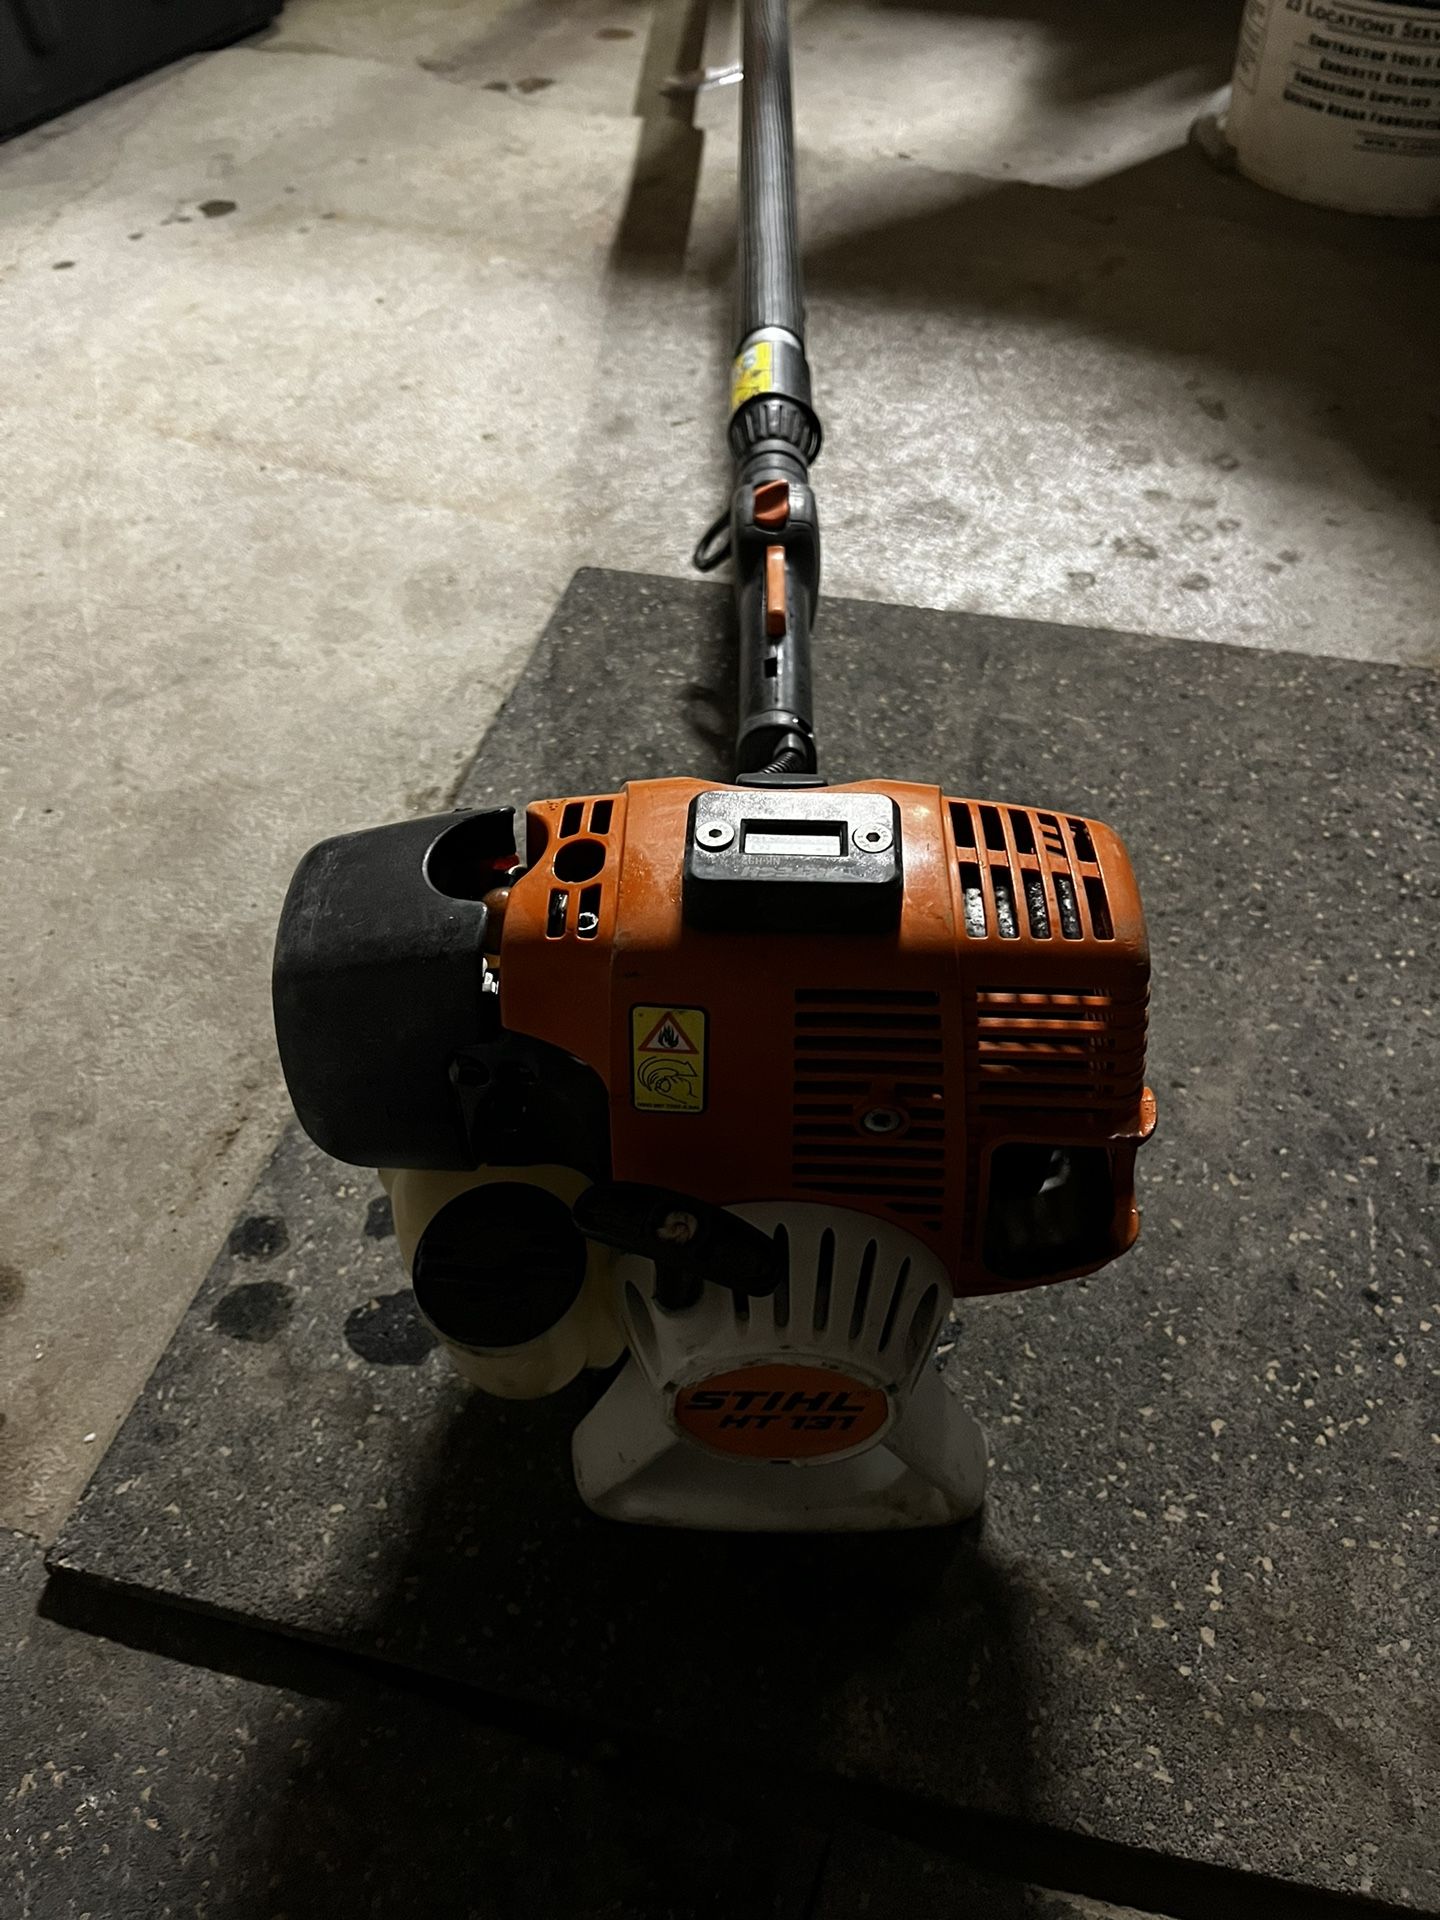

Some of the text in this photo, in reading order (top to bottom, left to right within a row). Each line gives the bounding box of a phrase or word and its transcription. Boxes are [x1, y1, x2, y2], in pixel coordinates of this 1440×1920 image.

[685, 1391, 865, 1412] STIHL
[719, 1414, 859, 1430] HT 131
